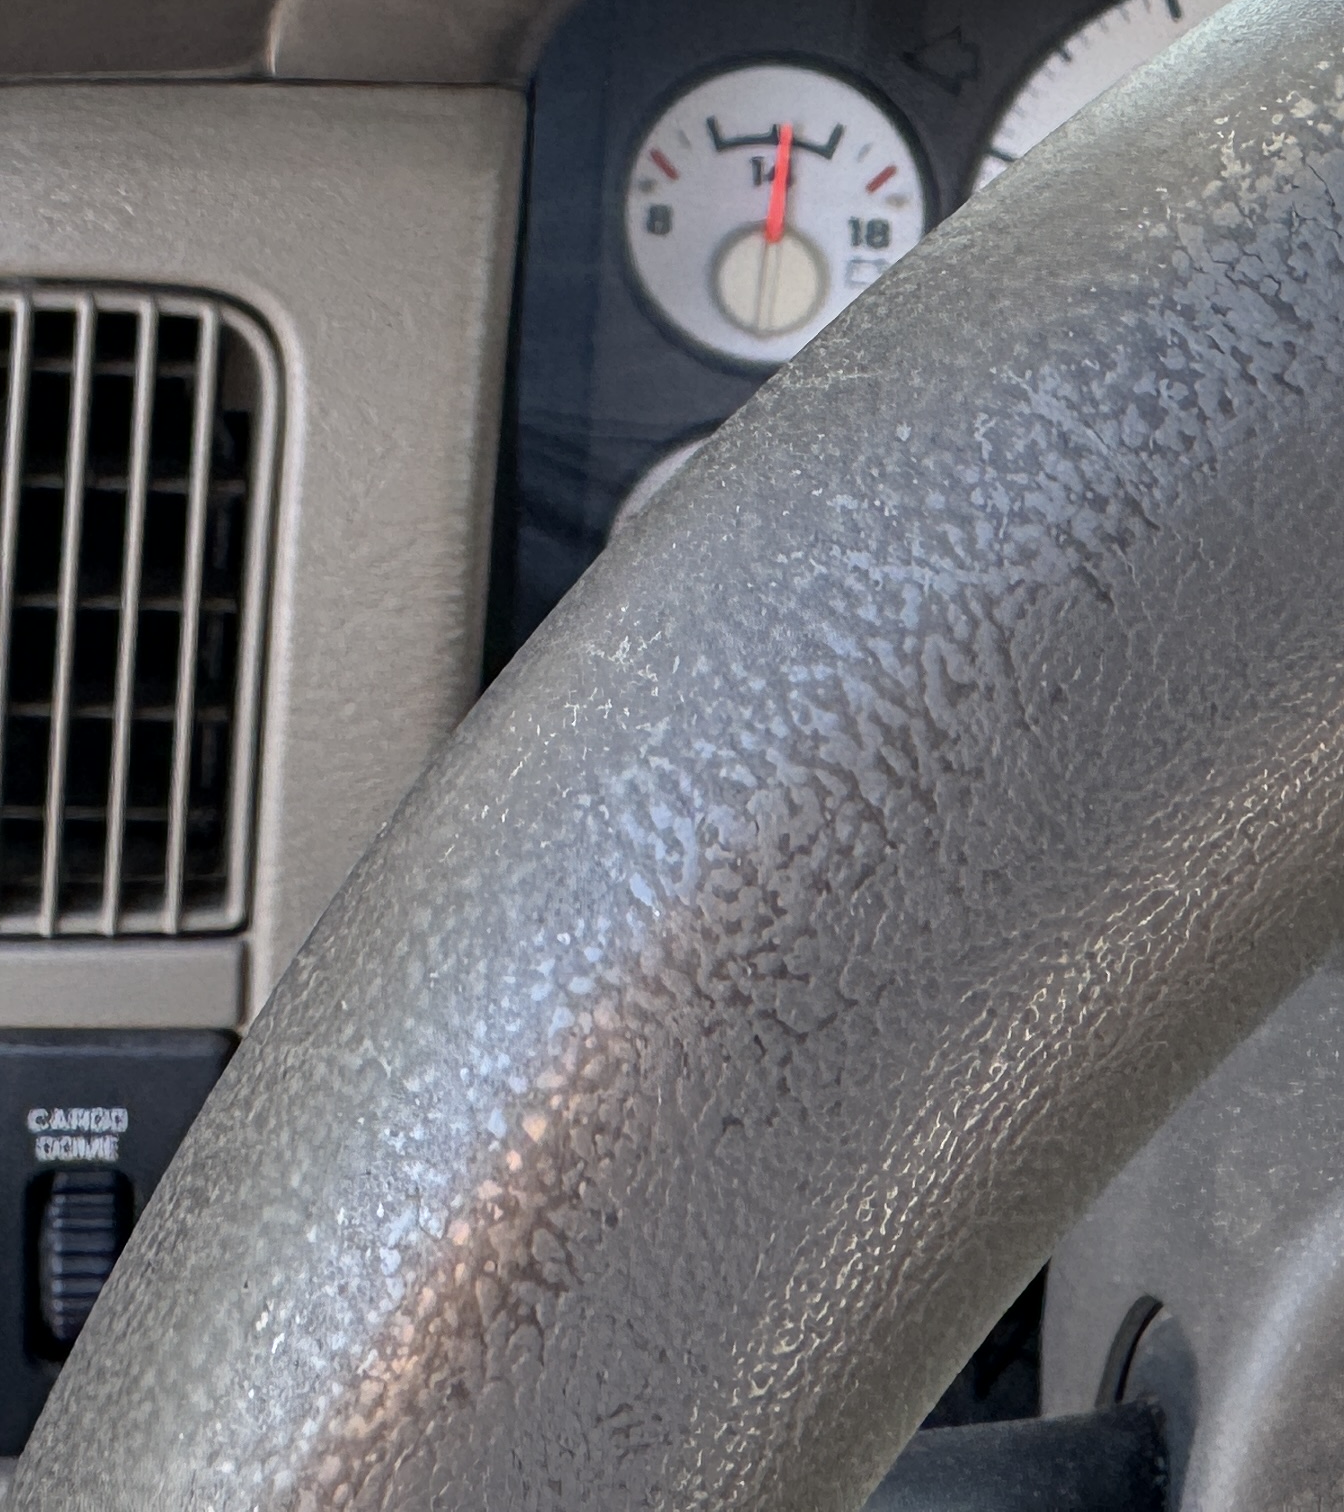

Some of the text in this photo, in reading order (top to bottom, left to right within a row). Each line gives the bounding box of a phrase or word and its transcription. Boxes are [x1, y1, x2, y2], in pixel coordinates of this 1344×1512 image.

[751, 155, 793, 188] 1
[645, 203, 674, 237] 8
[848, 215, 892, 249] 18
